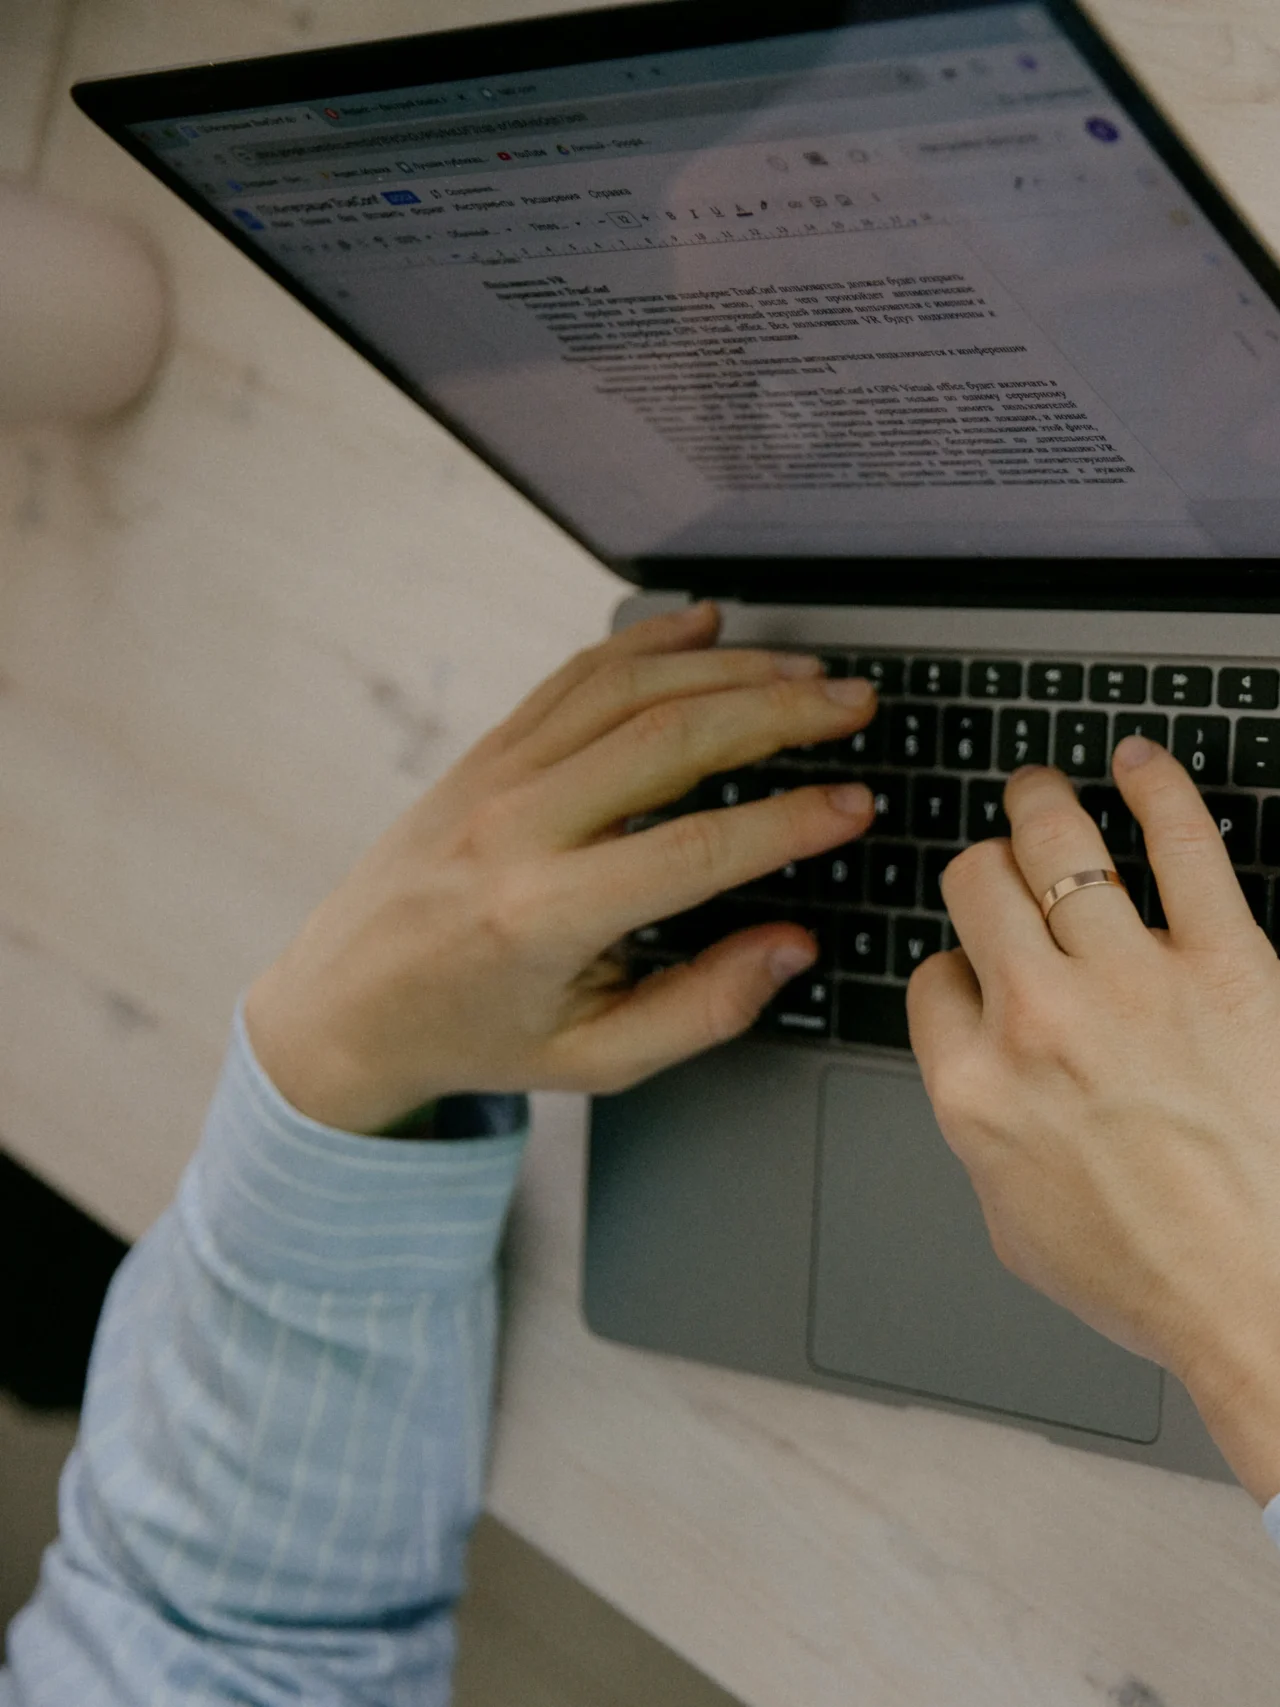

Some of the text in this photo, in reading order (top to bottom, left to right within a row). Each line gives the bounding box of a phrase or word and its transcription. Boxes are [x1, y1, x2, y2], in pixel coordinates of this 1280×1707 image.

[512, 147, 547, 158] YouTube
[452, 187, 632, 212] Инструменты Расширения Справка
[617, 215, 631, 224] 12
[730, 284, 778, 296] TrueConf
[777, 281, 846, 293] пользователь
[845, 278, 887, 290] должен
[885, 274, 919, 287] будет
[918, 273, 967, 285] открыть
[721, 301, 754, 310] меню,
[758, 298, 789, 306] после
[795, 296, 819, 304] чего
[824, 290, 888, 304] произойдет
[765, 307, 812, 319] текущей
[810, 306, 854, 315] локации
[854, 302, 923, 312] пользователя
[767, 320, 789, 329] Все
[791, 318, 860, 328] пользователи
[861, 315, 881, 324] VR
[882, 312, 916, 325] будут
[917, 310, 986, 322] подключены
[802, 353, 875, 362] автоматически
[875, 349, 948, 359] подключается
[955, 342, 1029, 357] конференции
[819, 385, 865, 395] TrueConf
[872, 384, 899, 393] GPN
[899, 382, 934, 392] Virtual
[933, 381, 965, 390] office
[965, 380, 997, 391] будет
[997, 380, 1049, 388] включать
[961, 393, 1002, 402] одному
[1005, 391, 1070, 401] серверному
[1001, 401, 1079, 411] пользователей
[993, 414, 1042, 423] локации,
[1037, 423, 1063, 431] этой
[1063, 422, 1099, 433] фичи,
[1033, 434, 1108, 443] длительности
[1095, 443, 1117, 451] VR
[1092, 465, 1137, 474] нужной
[1015, 741, 1028, 760] 7
[1072, 744, 1085, 765] 8
[1192, 751, 1205, 771] 0
[929, 797, 942, 817] T
[984, 801, 998, 822] Y
[1220, 818, 1233, 835] P
[908, 938, 924, 959] V
